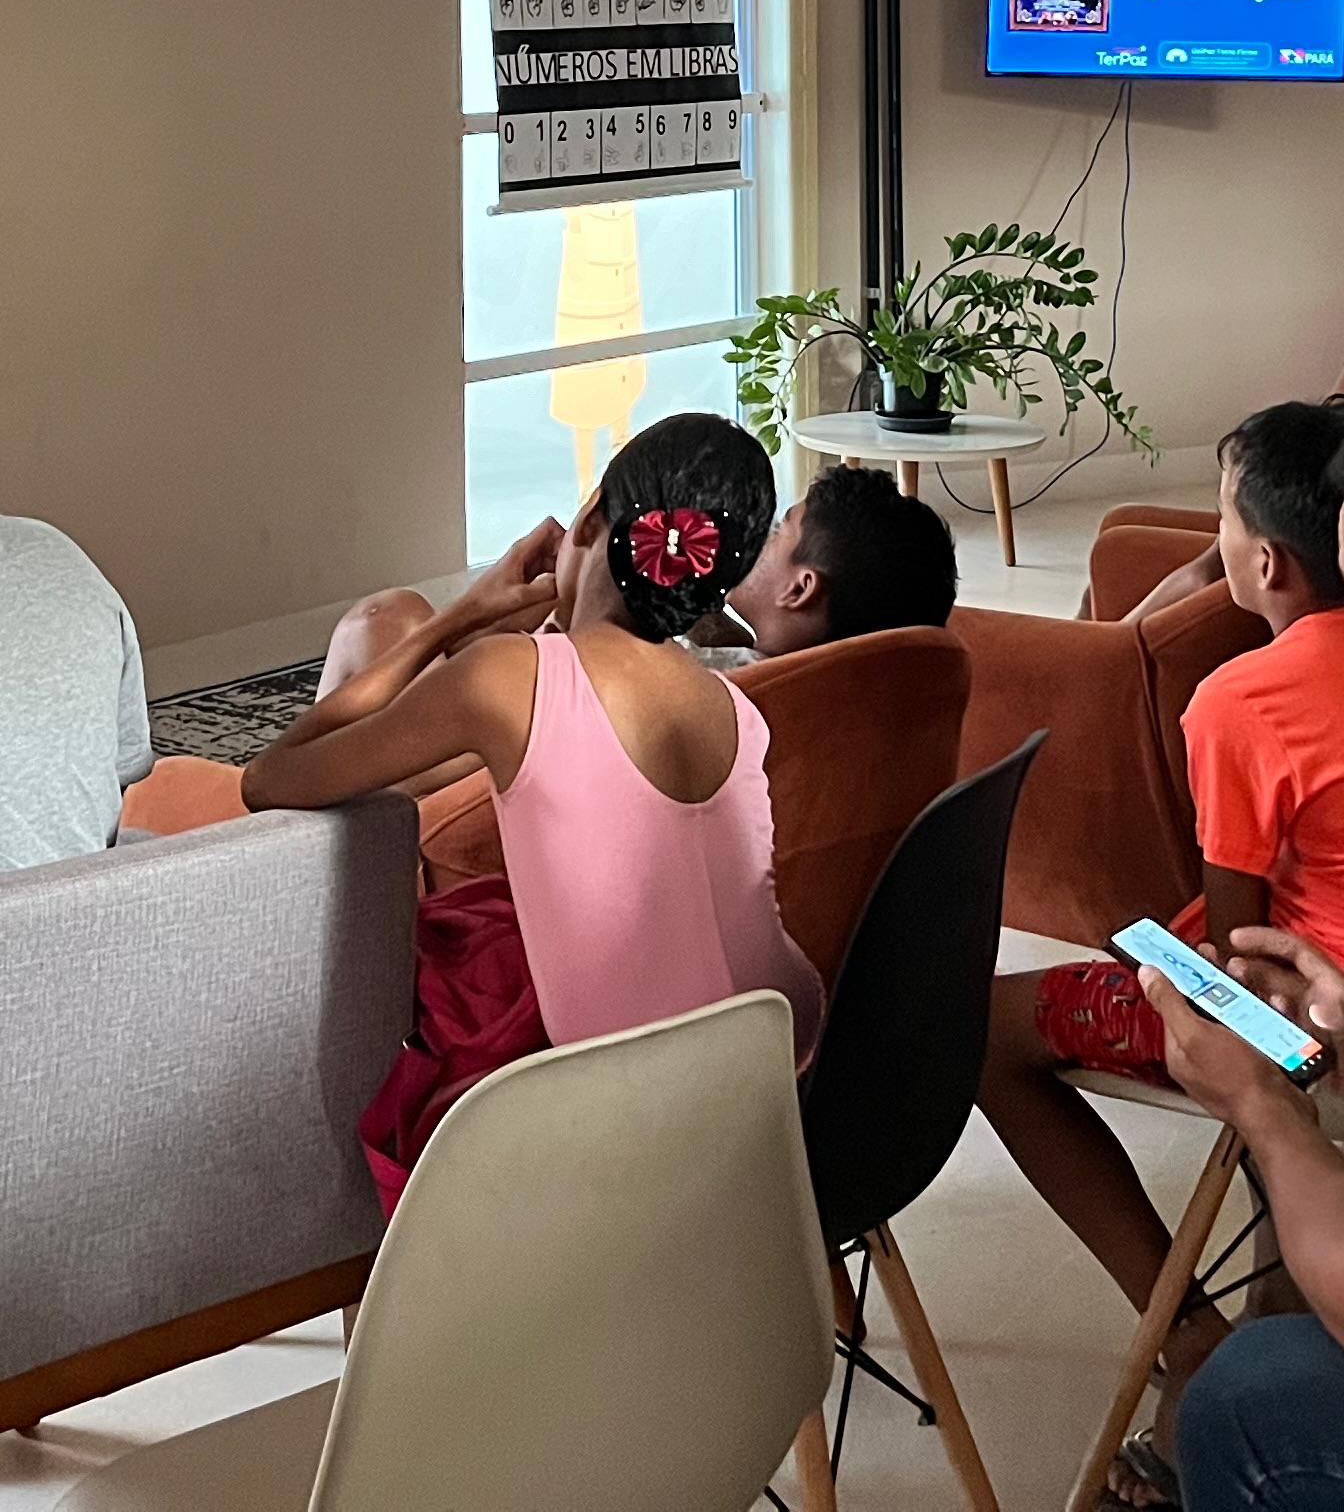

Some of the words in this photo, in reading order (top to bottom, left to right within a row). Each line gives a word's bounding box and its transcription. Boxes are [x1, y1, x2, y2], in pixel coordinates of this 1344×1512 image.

[497, 44, 617, 85] NÚMEROS
[627, 49, 662, 78] EM
[670, 45, 738, 77] LIBRAS
[1096, 51, 1148, 67] TerPaz
[504, 121, 514, 143] 0
[536, 120, 544, 141] 1
[557, 120, 567, 141] 2
[585, 118, 594, 139] 3
[606, 115, 616, 135] 4
[635, 113, 645, 133] 5
[656, 115, 666, 135] 6
[683, 113, 692, 133] 7
[702, 111, 711, 131] 8
[728, 110, 737, 130] 9
